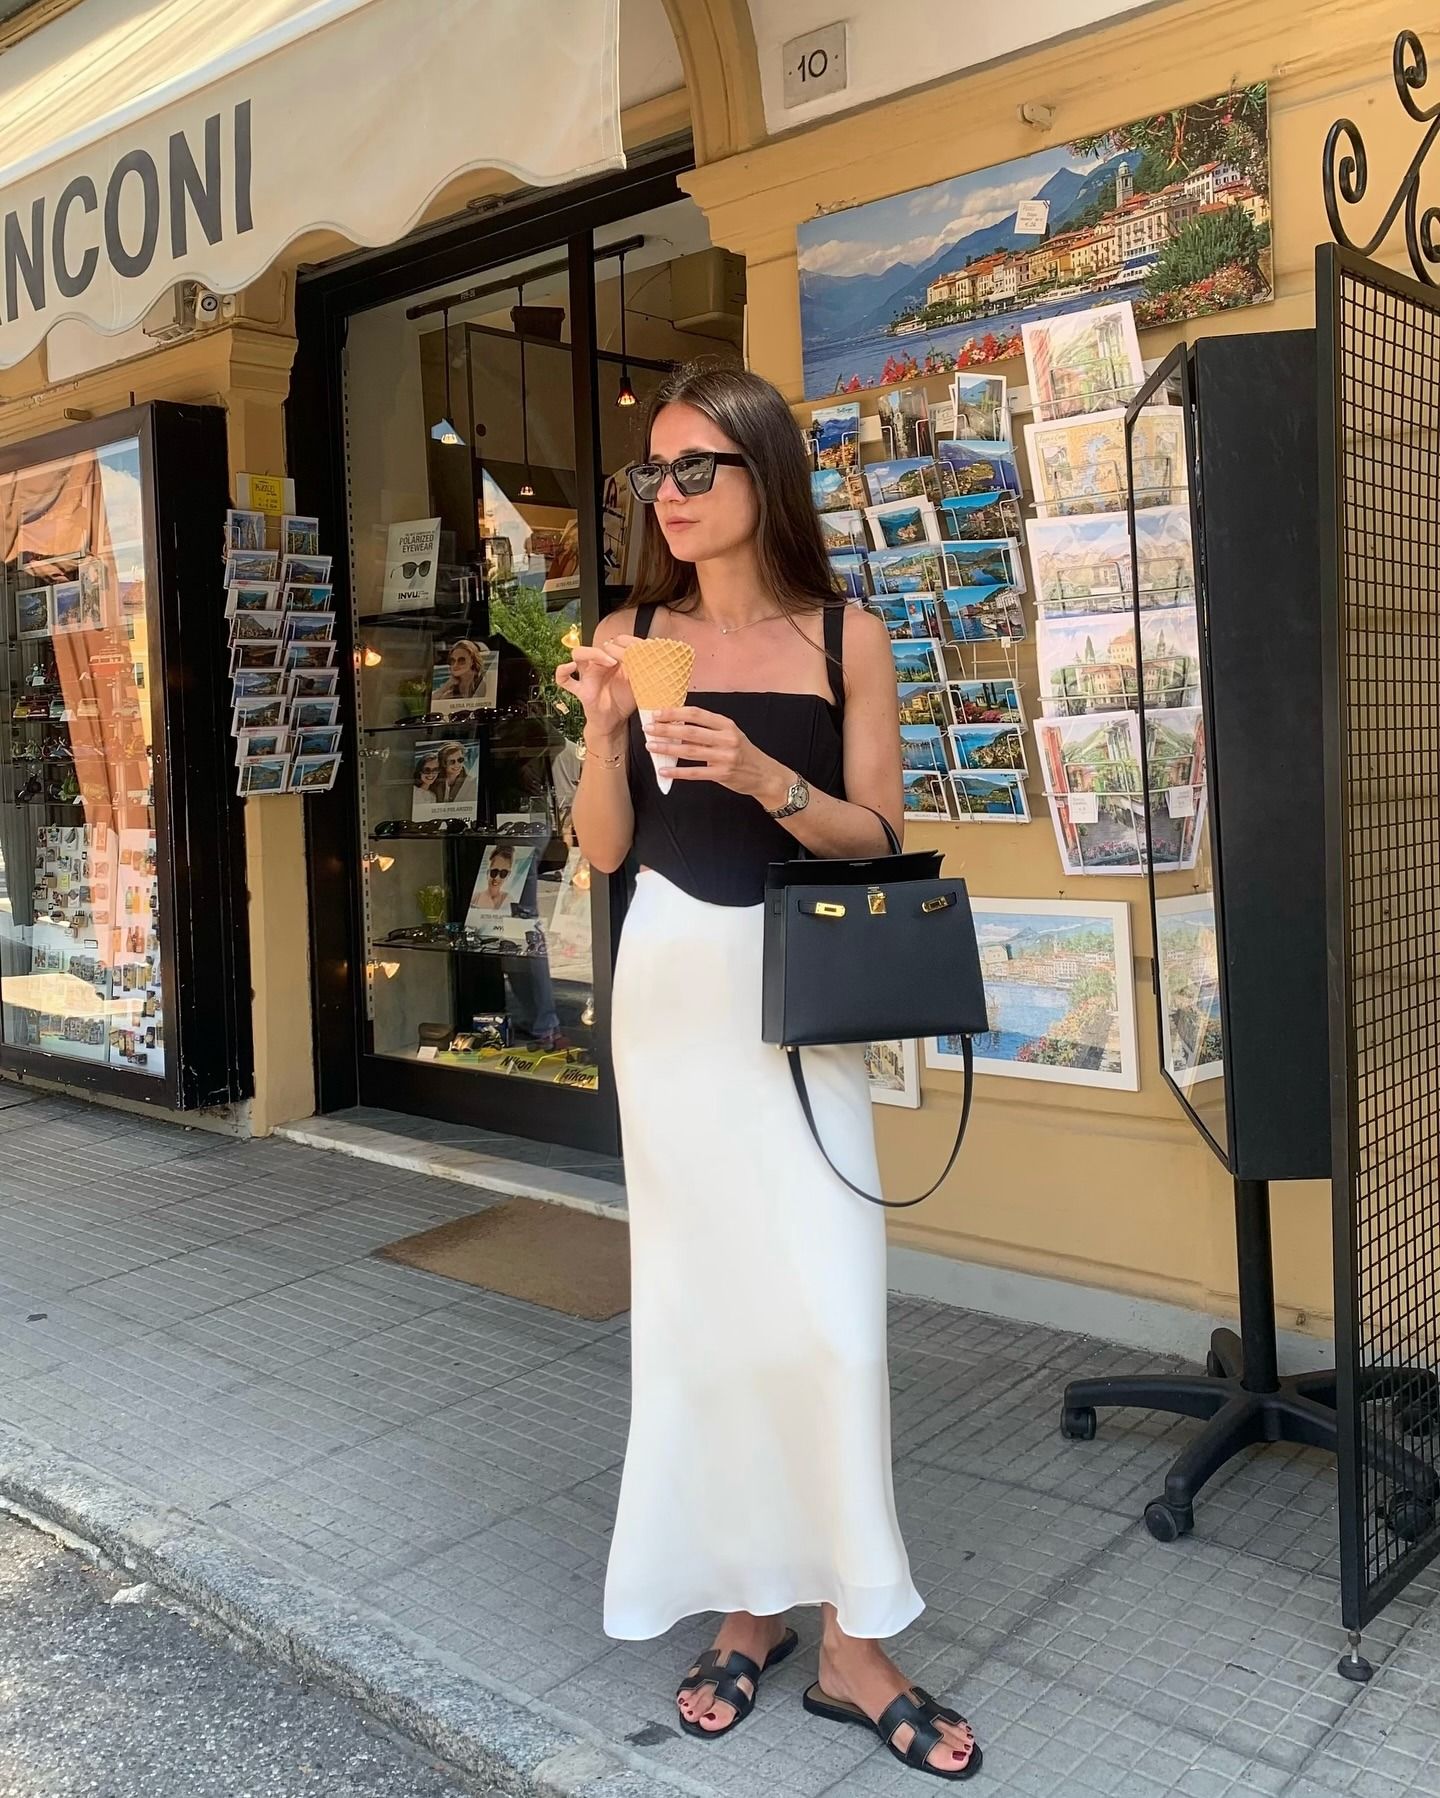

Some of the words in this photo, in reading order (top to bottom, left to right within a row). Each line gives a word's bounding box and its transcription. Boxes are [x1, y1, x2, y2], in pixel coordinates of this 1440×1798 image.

[797, 49, 828, 82] 10
[0, 98, 254, 326] NCONI
[399, 534, 434, 546] POLARIZED
[402, 542, 433, 553] EYEWEAR
